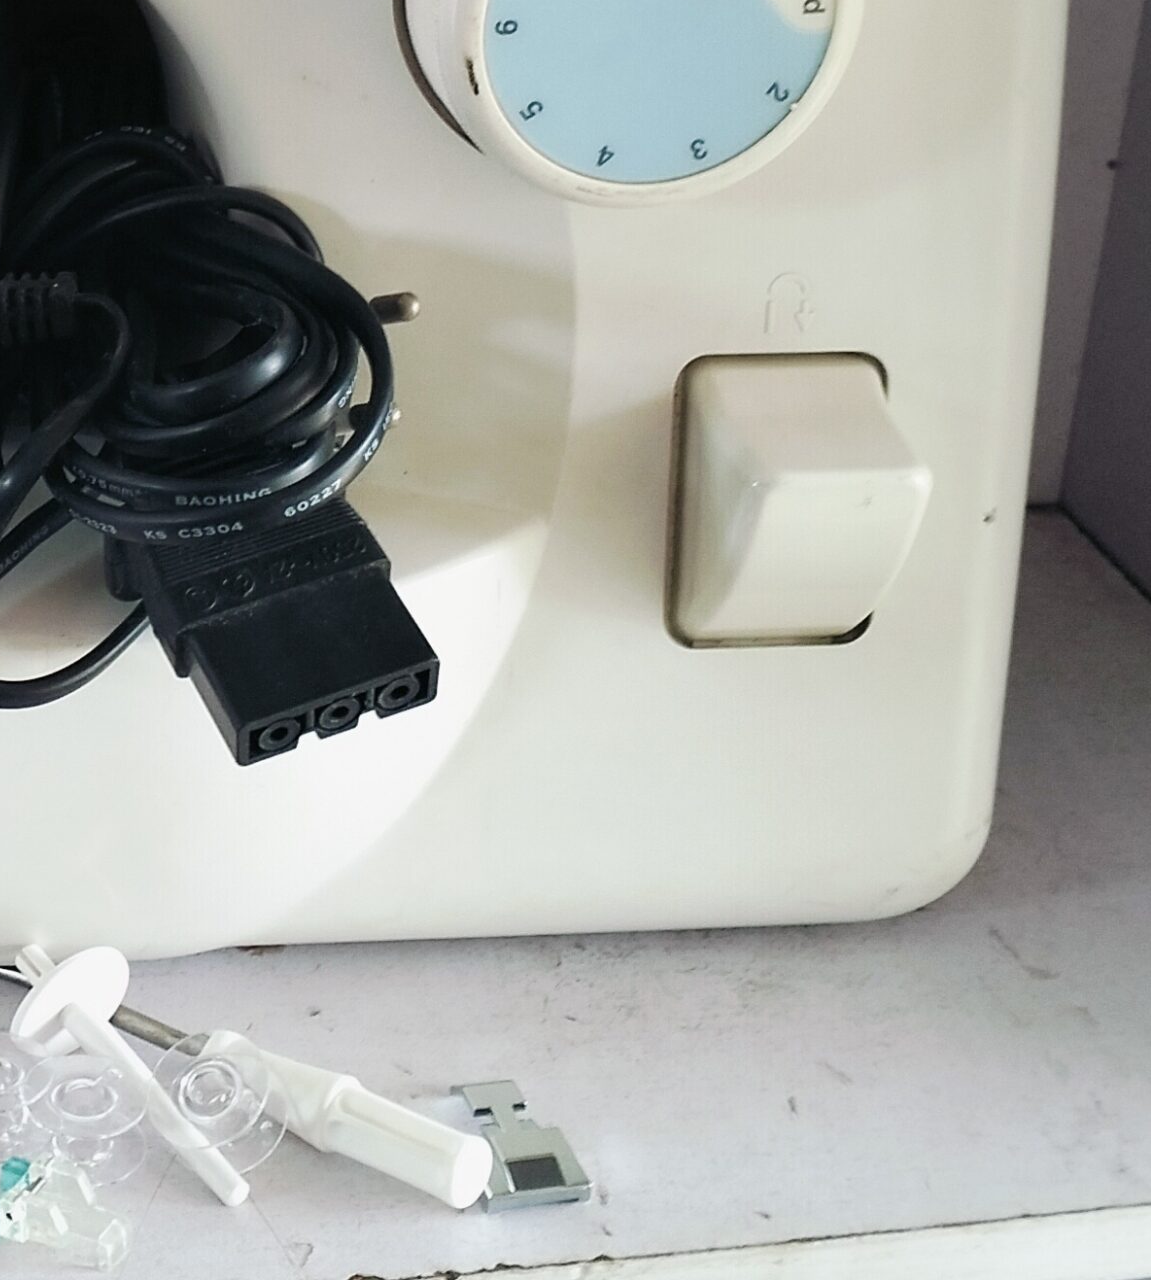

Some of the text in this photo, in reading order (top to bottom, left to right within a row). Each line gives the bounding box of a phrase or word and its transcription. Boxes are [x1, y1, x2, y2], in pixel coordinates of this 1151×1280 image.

[766, 82, 789, 102] 2
[519, 101, 544, 121] 5
[597, 145, 615, 167] 4
[690, 138, 708, 160] 3
[175, 487, 273, 507] BAOHING
[177, 520, 244, 540] C3304
[283, 480, 342, 519] 60227
